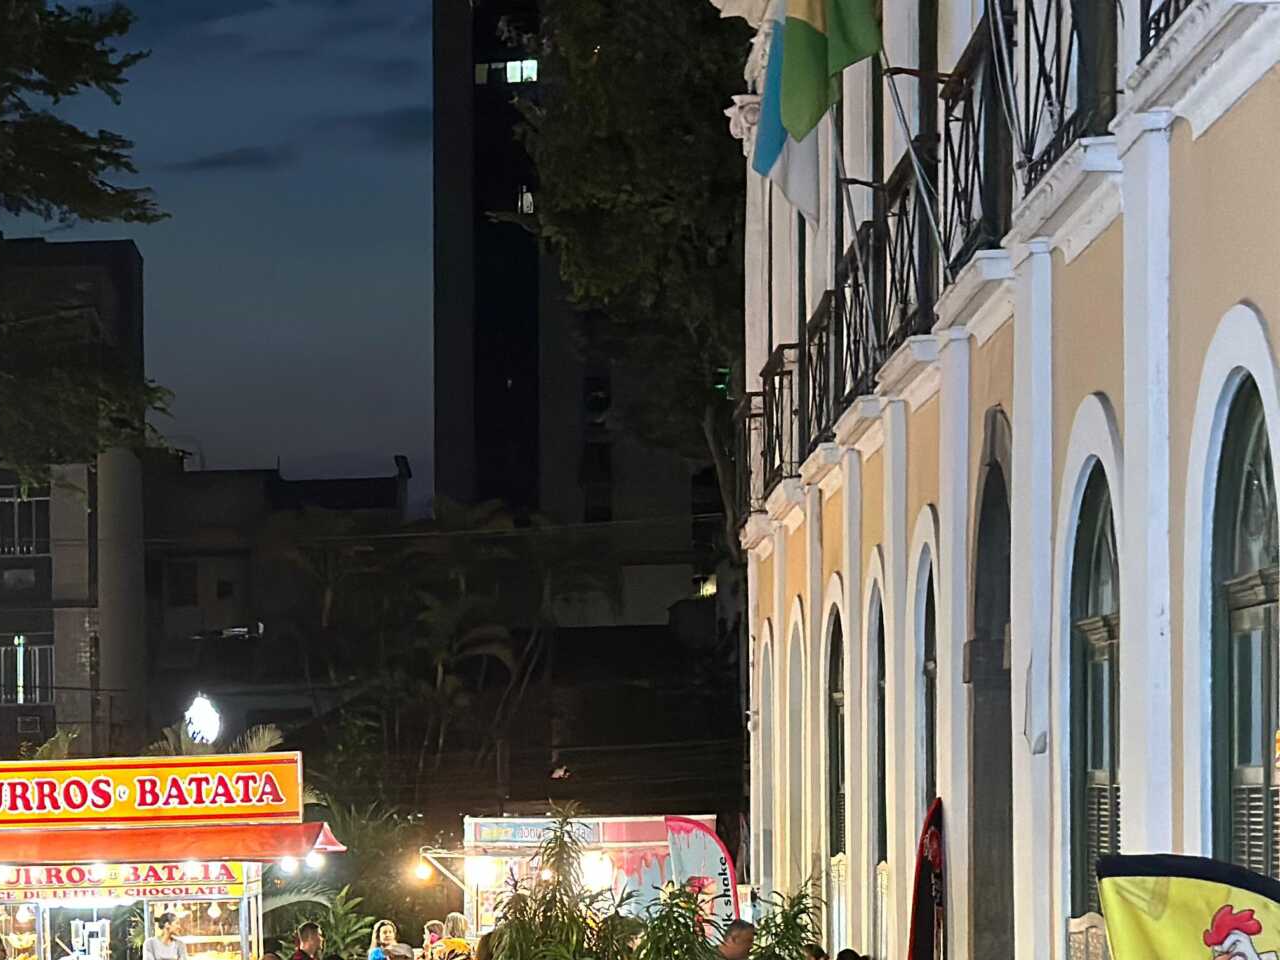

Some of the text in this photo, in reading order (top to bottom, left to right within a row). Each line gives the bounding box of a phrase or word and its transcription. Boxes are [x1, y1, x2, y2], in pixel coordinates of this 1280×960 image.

[137, 773, 284, 807] BATATA
[124, 886, 228, 897] CHOCOLATE
[717, 856, 733, 907] shake
